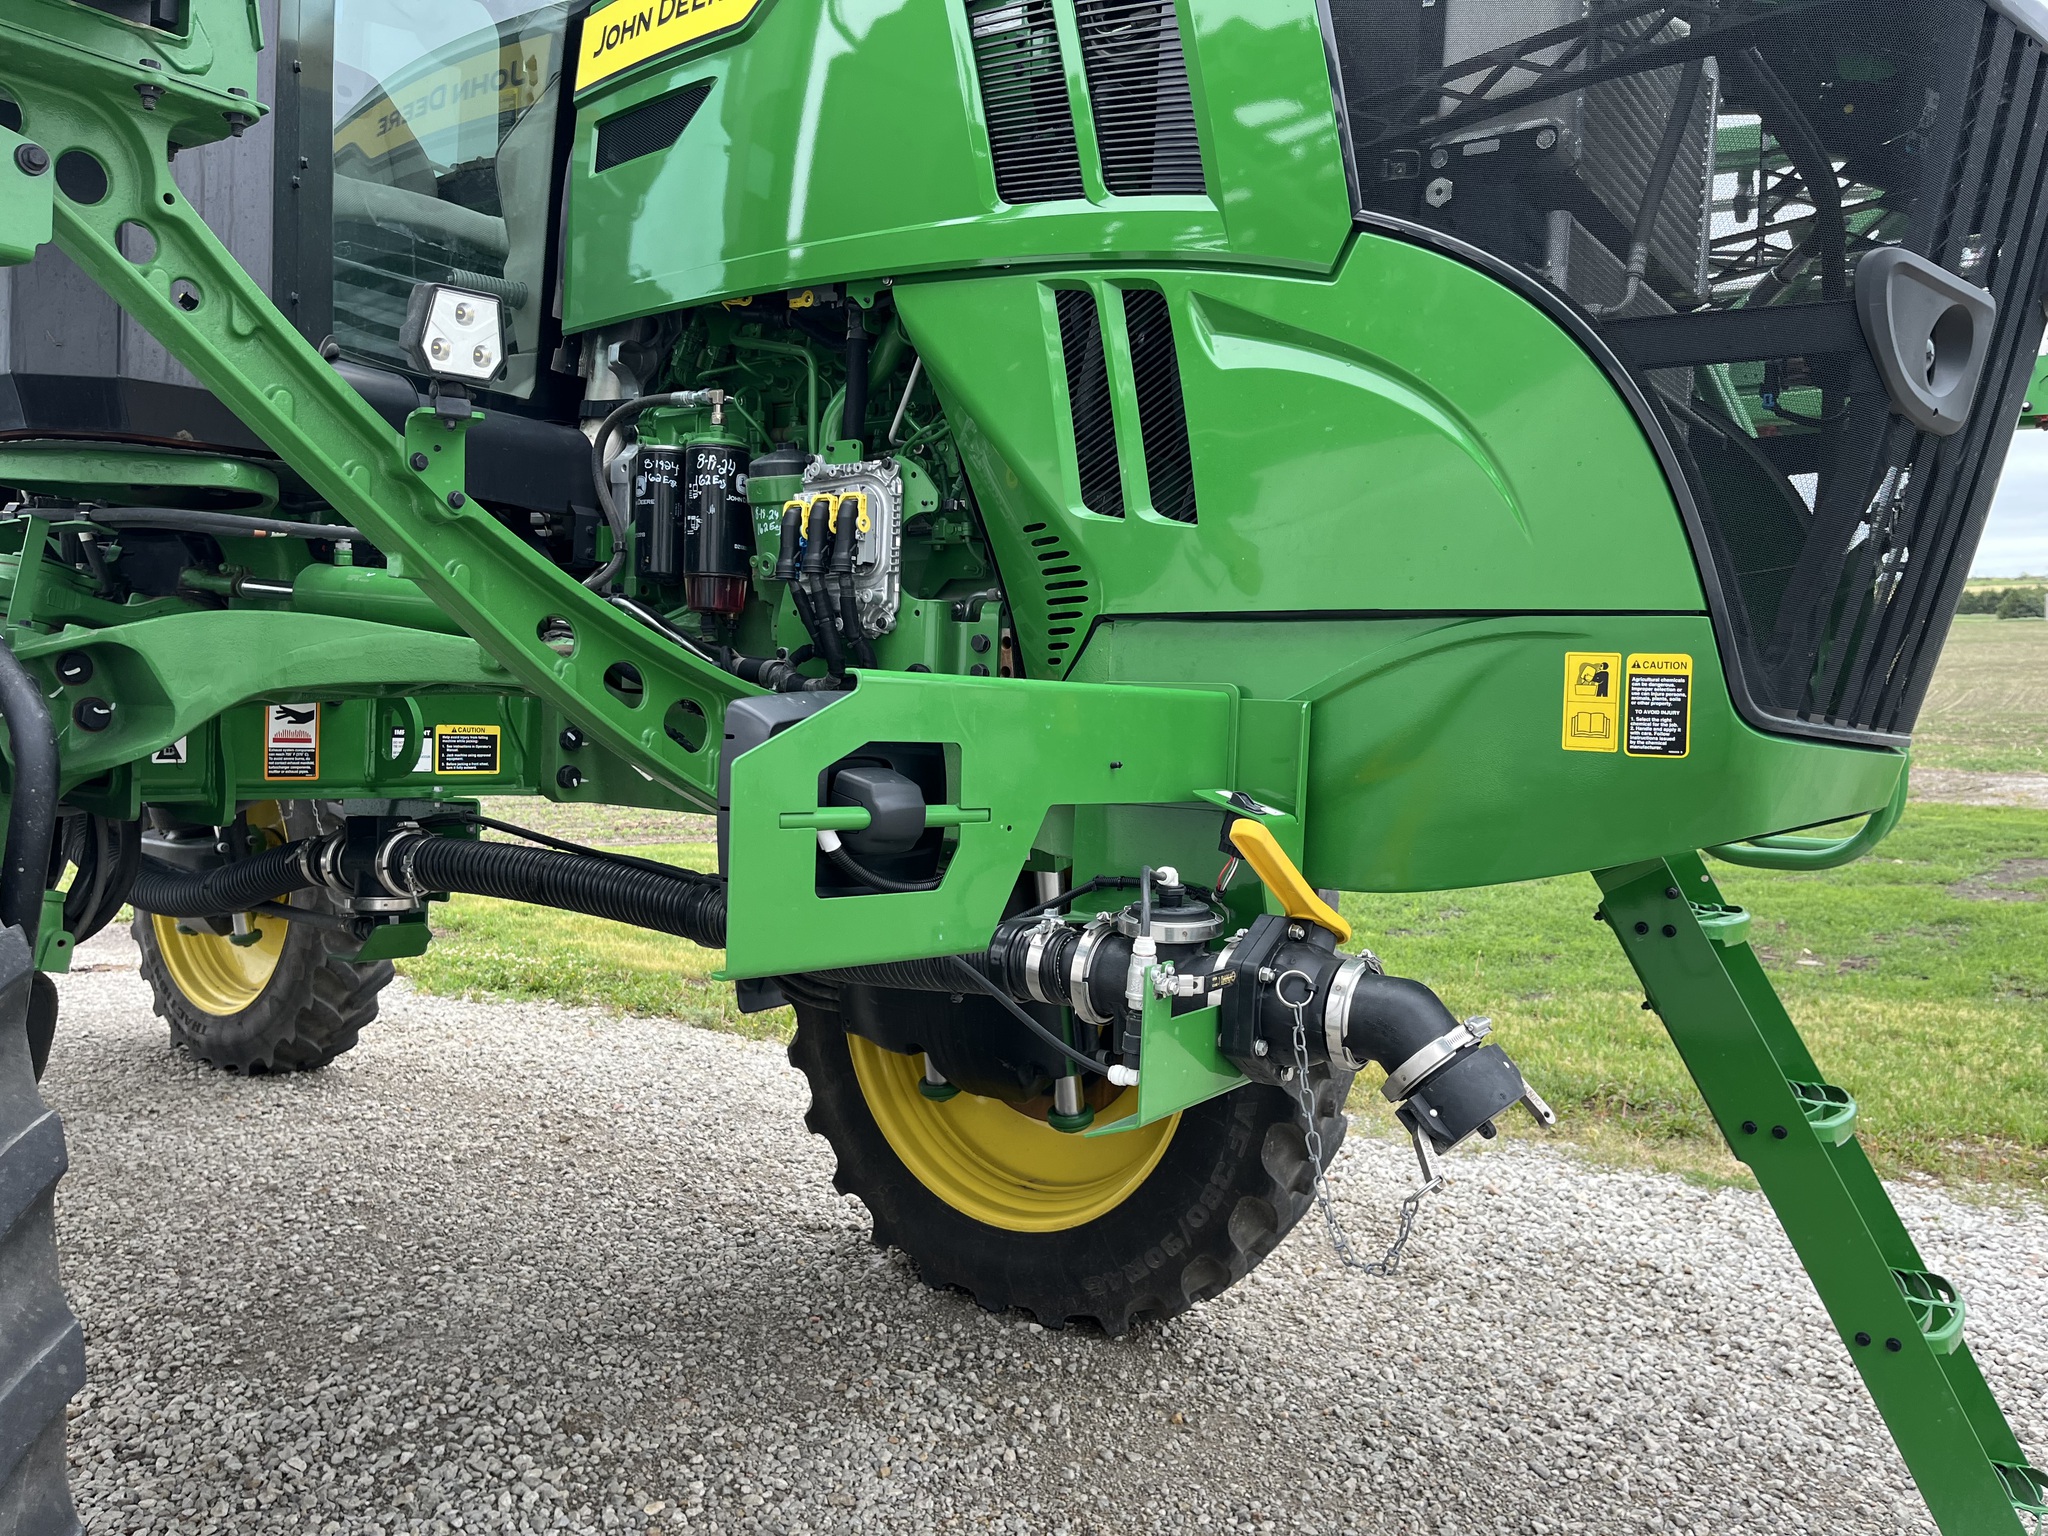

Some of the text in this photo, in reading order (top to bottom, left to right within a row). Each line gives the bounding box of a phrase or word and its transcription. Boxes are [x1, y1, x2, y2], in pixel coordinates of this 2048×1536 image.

[593, 7, 653, 58] JOHN
[695, 474, 711, 486] 162
[726, 494, 743, 502] JOHN
[1642, 660, 1688, 670] CAUTION
